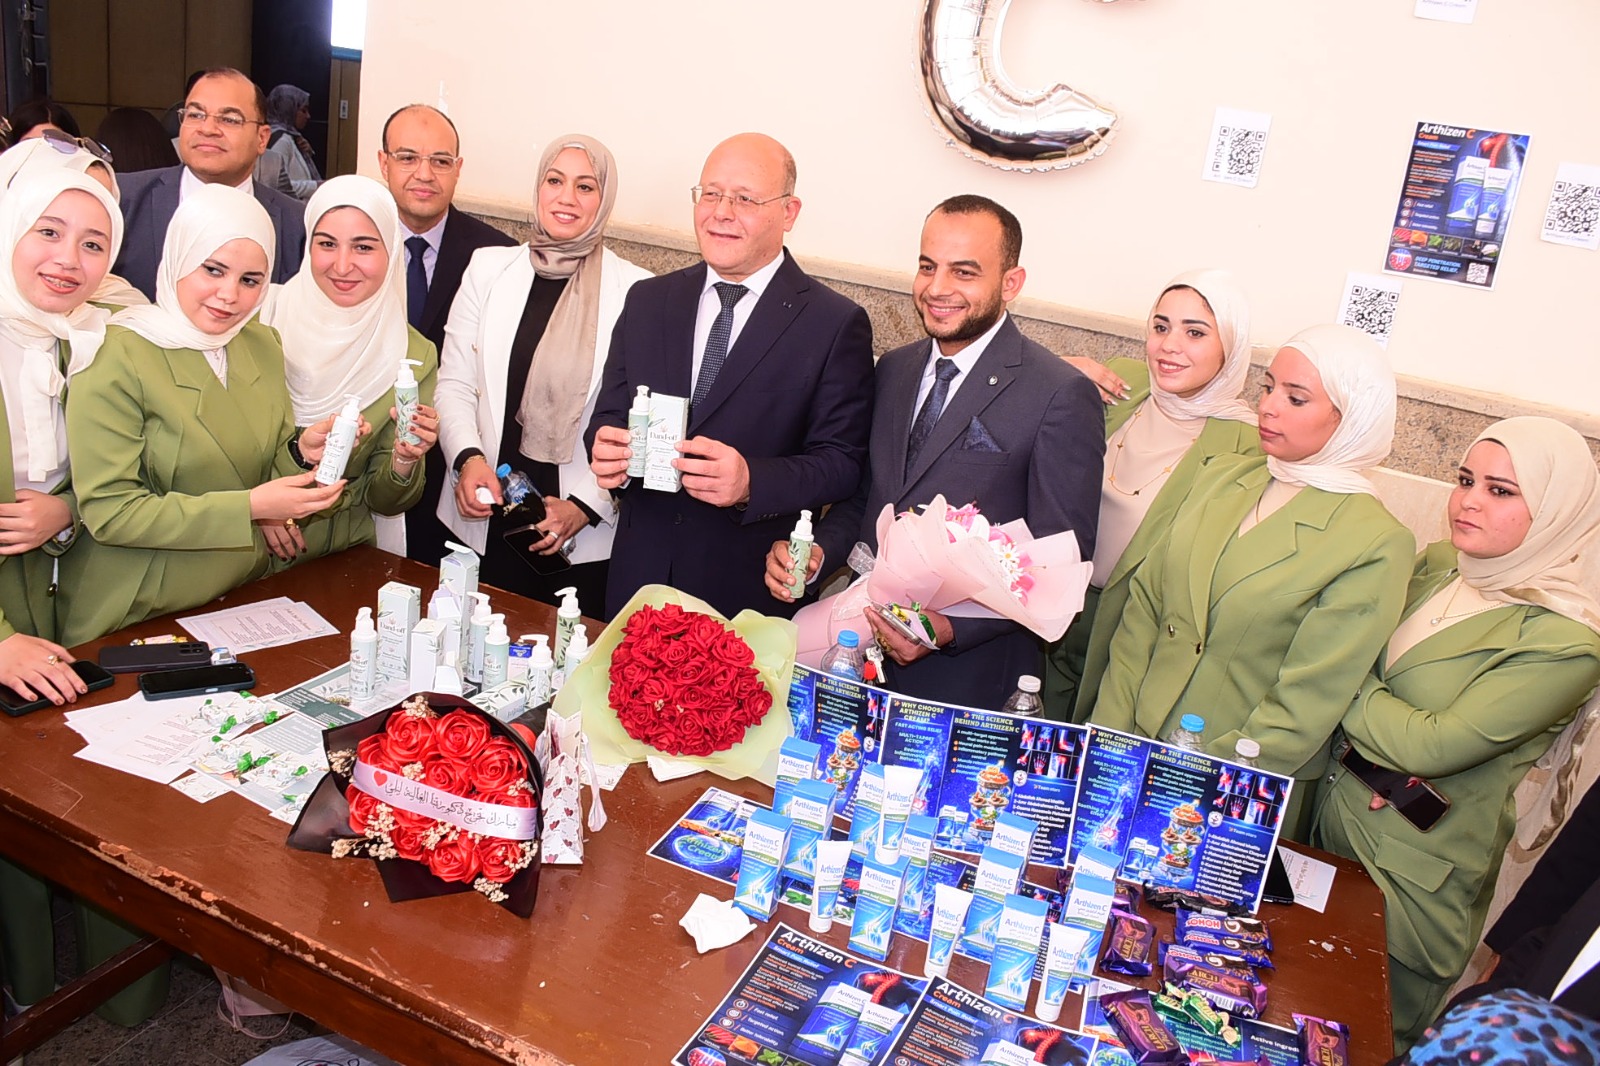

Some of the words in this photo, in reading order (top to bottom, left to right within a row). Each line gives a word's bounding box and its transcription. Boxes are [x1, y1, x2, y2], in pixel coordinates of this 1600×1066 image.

[1420, 123, 1466, 138] Arthizen
[1466, 129, 1476, 139] C
[1414, 262, 1440, 270] TARGETED
[1441, 265, 1458, 273] RELIEF.
[838, 681, 859, 692] SCIENCE
[899, 708, 930, 717] ARTHIZEN
[901, 702, 917, 710] WHY
[918, 703, 944, 714] CHOOSE
[904, 714, 930, 723] CREAM?
[954, 718, 979, 727] BEHIND
[980, 721, 1014, 732] ARTHIZEN
[986, 716, 1014, 726] SCIENCE
[908, 723, 927, 731] ACTING
[899, 732, 935, 742] MULTI-TARGET
[1095, 737, 1128, 749] ARTHIZEN
[1098, 730, 1114, 740] WHY
[1114, 733, 1142, 747] CHOOSE
[1100, 744, 1126, 754] CREAM?
[781, 758, 804, 770] Arthizen
[1090, 750, 1102, 758] FAST
[1103, 753, 1122, 762] ACTING
[1122, 758, 1138, 766] RELIEF
[1150, 752, 1176, 763] BEHIND
[1177, 758, 1212, 773] ARTHIZEN
[1168, 750, 1182, 758] THE
[1182, 753, 1212, 766] SCIENCE
[1093, 760, 1130, 772] MULTI-TARGET
[1099, 767, 1118, 775] ACTION
[862, 781, 884, 794] Arthiz
[887, 792, 908, 801] Arthizen
[909, 794, 913, 802] C
[795, 800, 818, 812] Arthizen
[749, 831, 774, 845] Arthizen
[775, 839, 779, 847] C
[903, 837, 921, 847] thizen
[996, 833, 1020, 846] Arthizen
[820, 865, 841, 873] Arthizen
[865, 871, 891, 885] Arthizen
[981, 870, 1007, 884] Arthizen
[1074, 898, 1102, 910] Arthizen
[1102, 904, 1108, 912] C
[936, 907, 956, 920] Arthizen
[956, 913, 961, 922] C
[1005, 918, 1033, 933] Arthizen
[777, 938, 805, 955] Cream
[781, 931, 843, 964] Arthizen
[844, 958, 858, 969] C
[1052, 946, 1074, 960] Arthizen
[1074, 951, 1079, 960] C
[773, 945, 790, 956] Smart
[790, 952, 803, 962] Pain
[802, 958, 820, 969] Relief
[838, 989, 861, 1002] Arthizen
[933, 990, 961, 1009] Cream
[936, 982, 1002, 1019] Arthizen
[1003, 1013, 1016, 1024] C
[753, 1007, 766, 1016] Fast
[766, 1012, 779, 1021] relief
[929, 998, 948, 1010] Smart
[948, 1006, 962, 1017] Pain
[961, 1012, 978, 1024] Relief
[739, 1027, 754, 1037] Better
[748, 1017, 769, 1030] Targeted
[770, 1026, 785, 1036] action
[1250, 1035, 1273, 1046] Active
[1274, 1041, 1299, 1053] Ingredi
